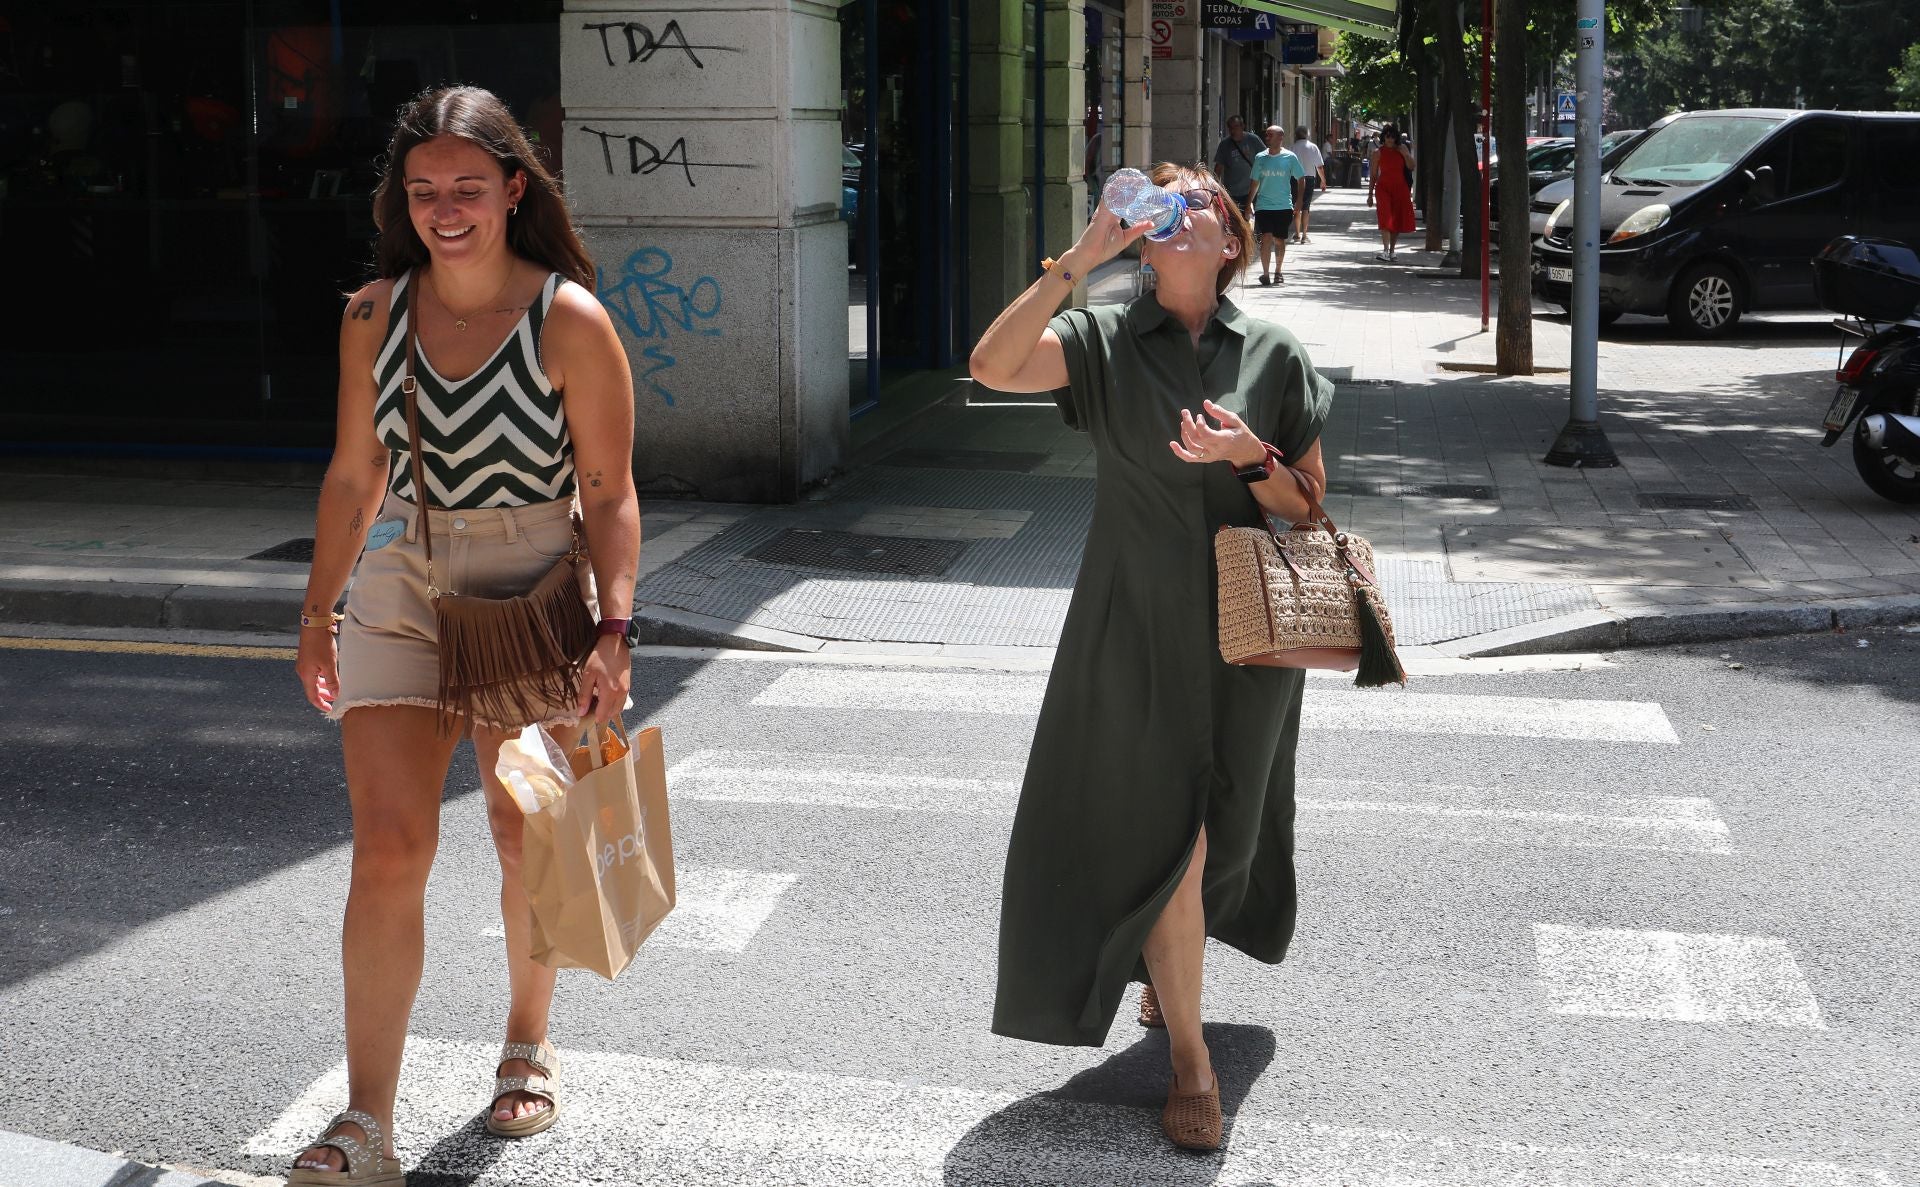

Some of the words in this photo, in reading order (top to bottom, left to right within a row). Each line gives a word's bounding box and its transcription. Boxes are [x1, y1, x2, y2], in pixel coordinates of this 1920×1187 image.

[582, 19, 746, 69] TDA
[1213, 16, 1242, 25] COPAS
[580, 125, 761, 187] TDA
